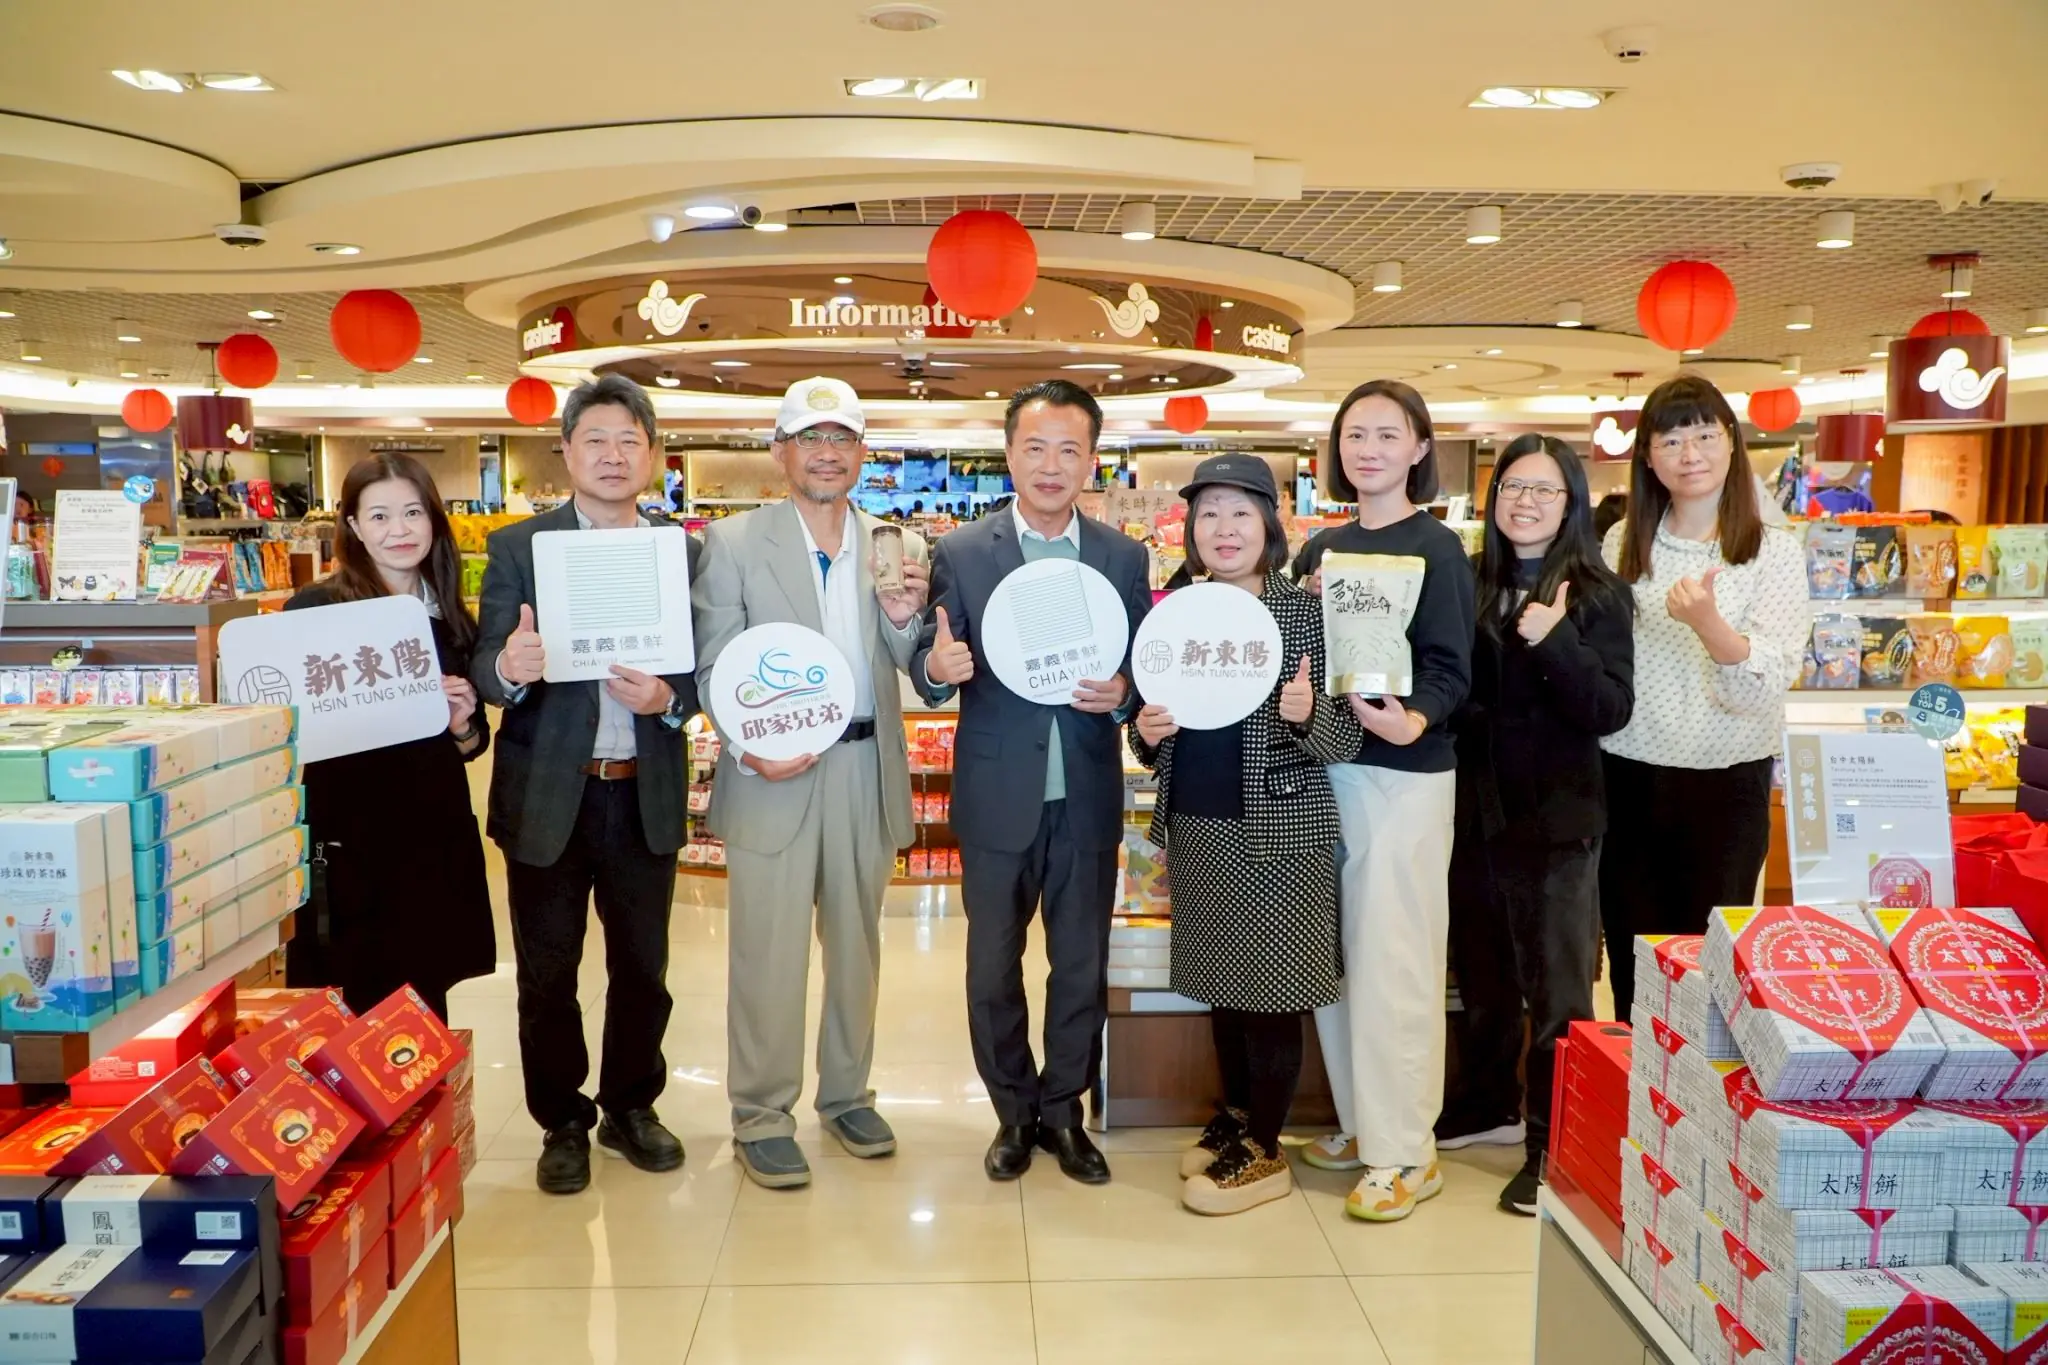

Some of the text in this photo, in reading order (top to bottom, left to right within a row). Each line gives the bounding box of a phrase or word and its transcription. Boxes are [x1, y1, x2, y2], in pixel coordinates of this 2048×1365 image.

[571, 632, 664, 655] 嘉義優鮮
[1024, 643, 1098, 673] 嘉義優鮮
[1180, 639, 1270, 668] 新東陽
[303, 637, 431, 698] 新東陽
[1028, 660, 1103, 689] CHIAYUM
[1181, 668, 1269, 679] HSIN TUNG YANG
[311, 679, 438, 714] HSIN TUNG YANG
[1934, 695, 1948, 713] 5
[740, 702, 843, 740] 邱家兄弟
[1818, 1173, 1898, 1197] 太陽餅
